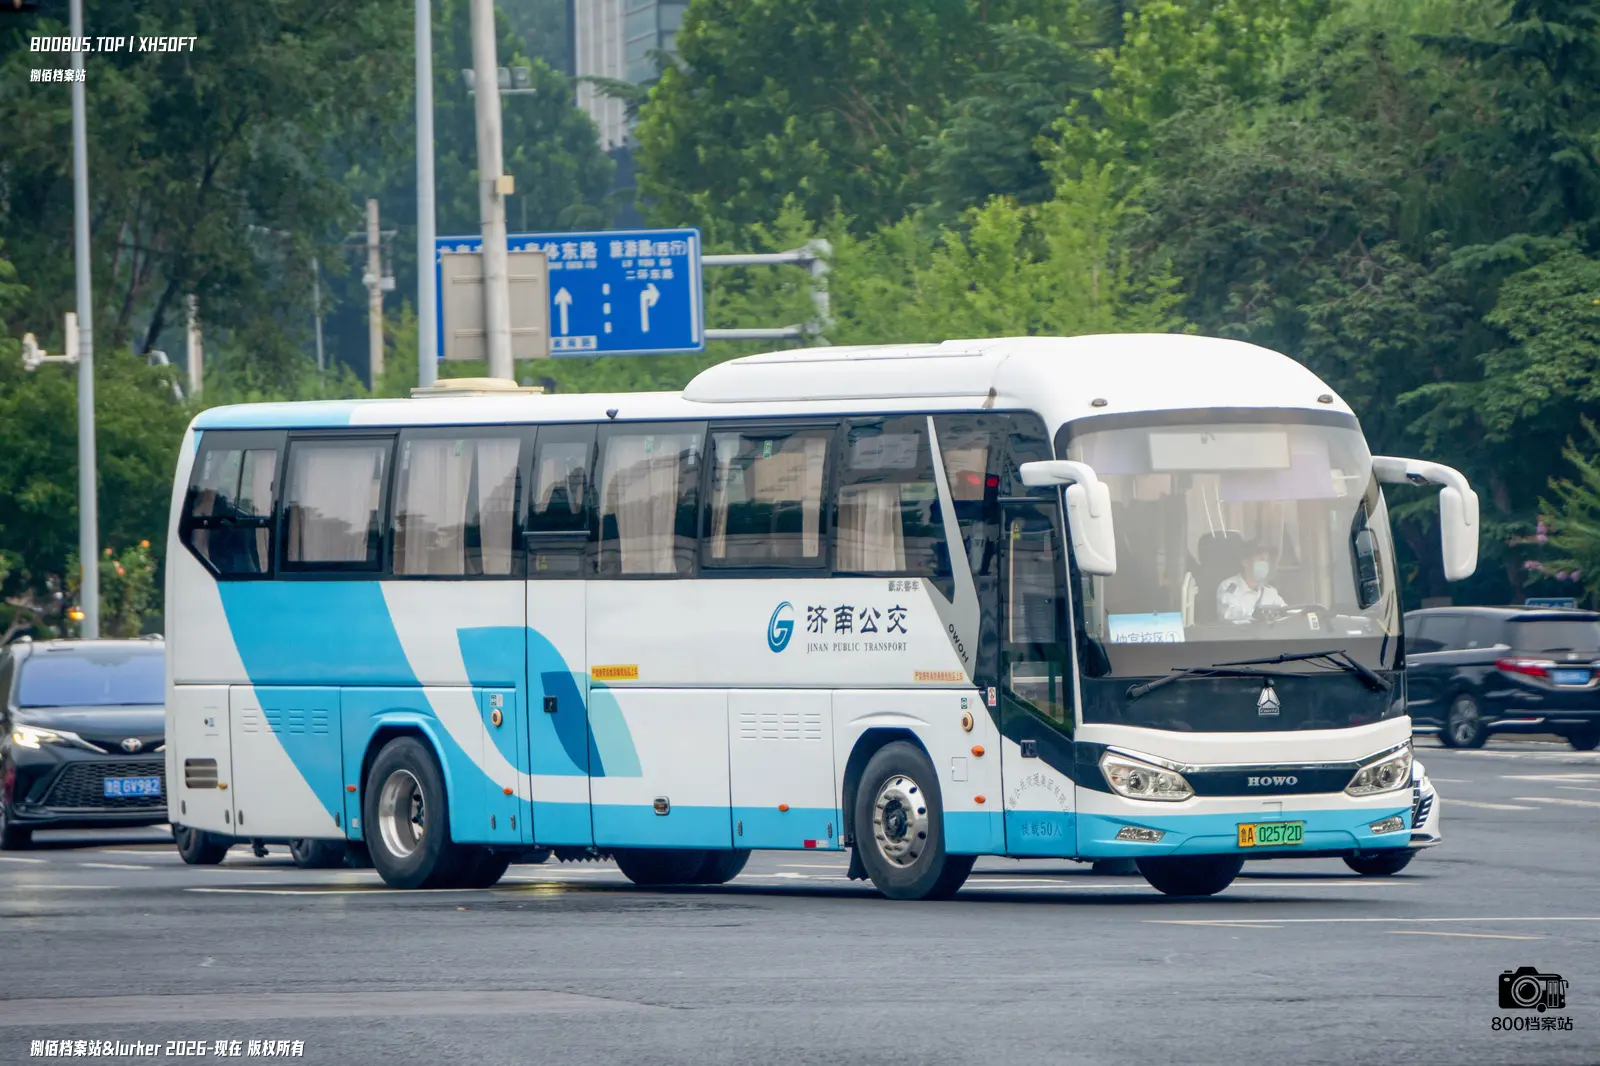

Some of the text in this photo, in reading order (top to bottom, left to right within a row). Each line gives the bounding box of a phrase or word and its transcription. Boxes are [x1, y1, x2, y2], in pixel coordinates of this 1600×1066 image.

[806, 604, 908, 635] 济南公交
[806, 642, 907, 653] JINAN PUBLIC TRANSPORT
[948, 623, 969, 663] HOWO
[1247, 775, 1298, 787] HOWO
